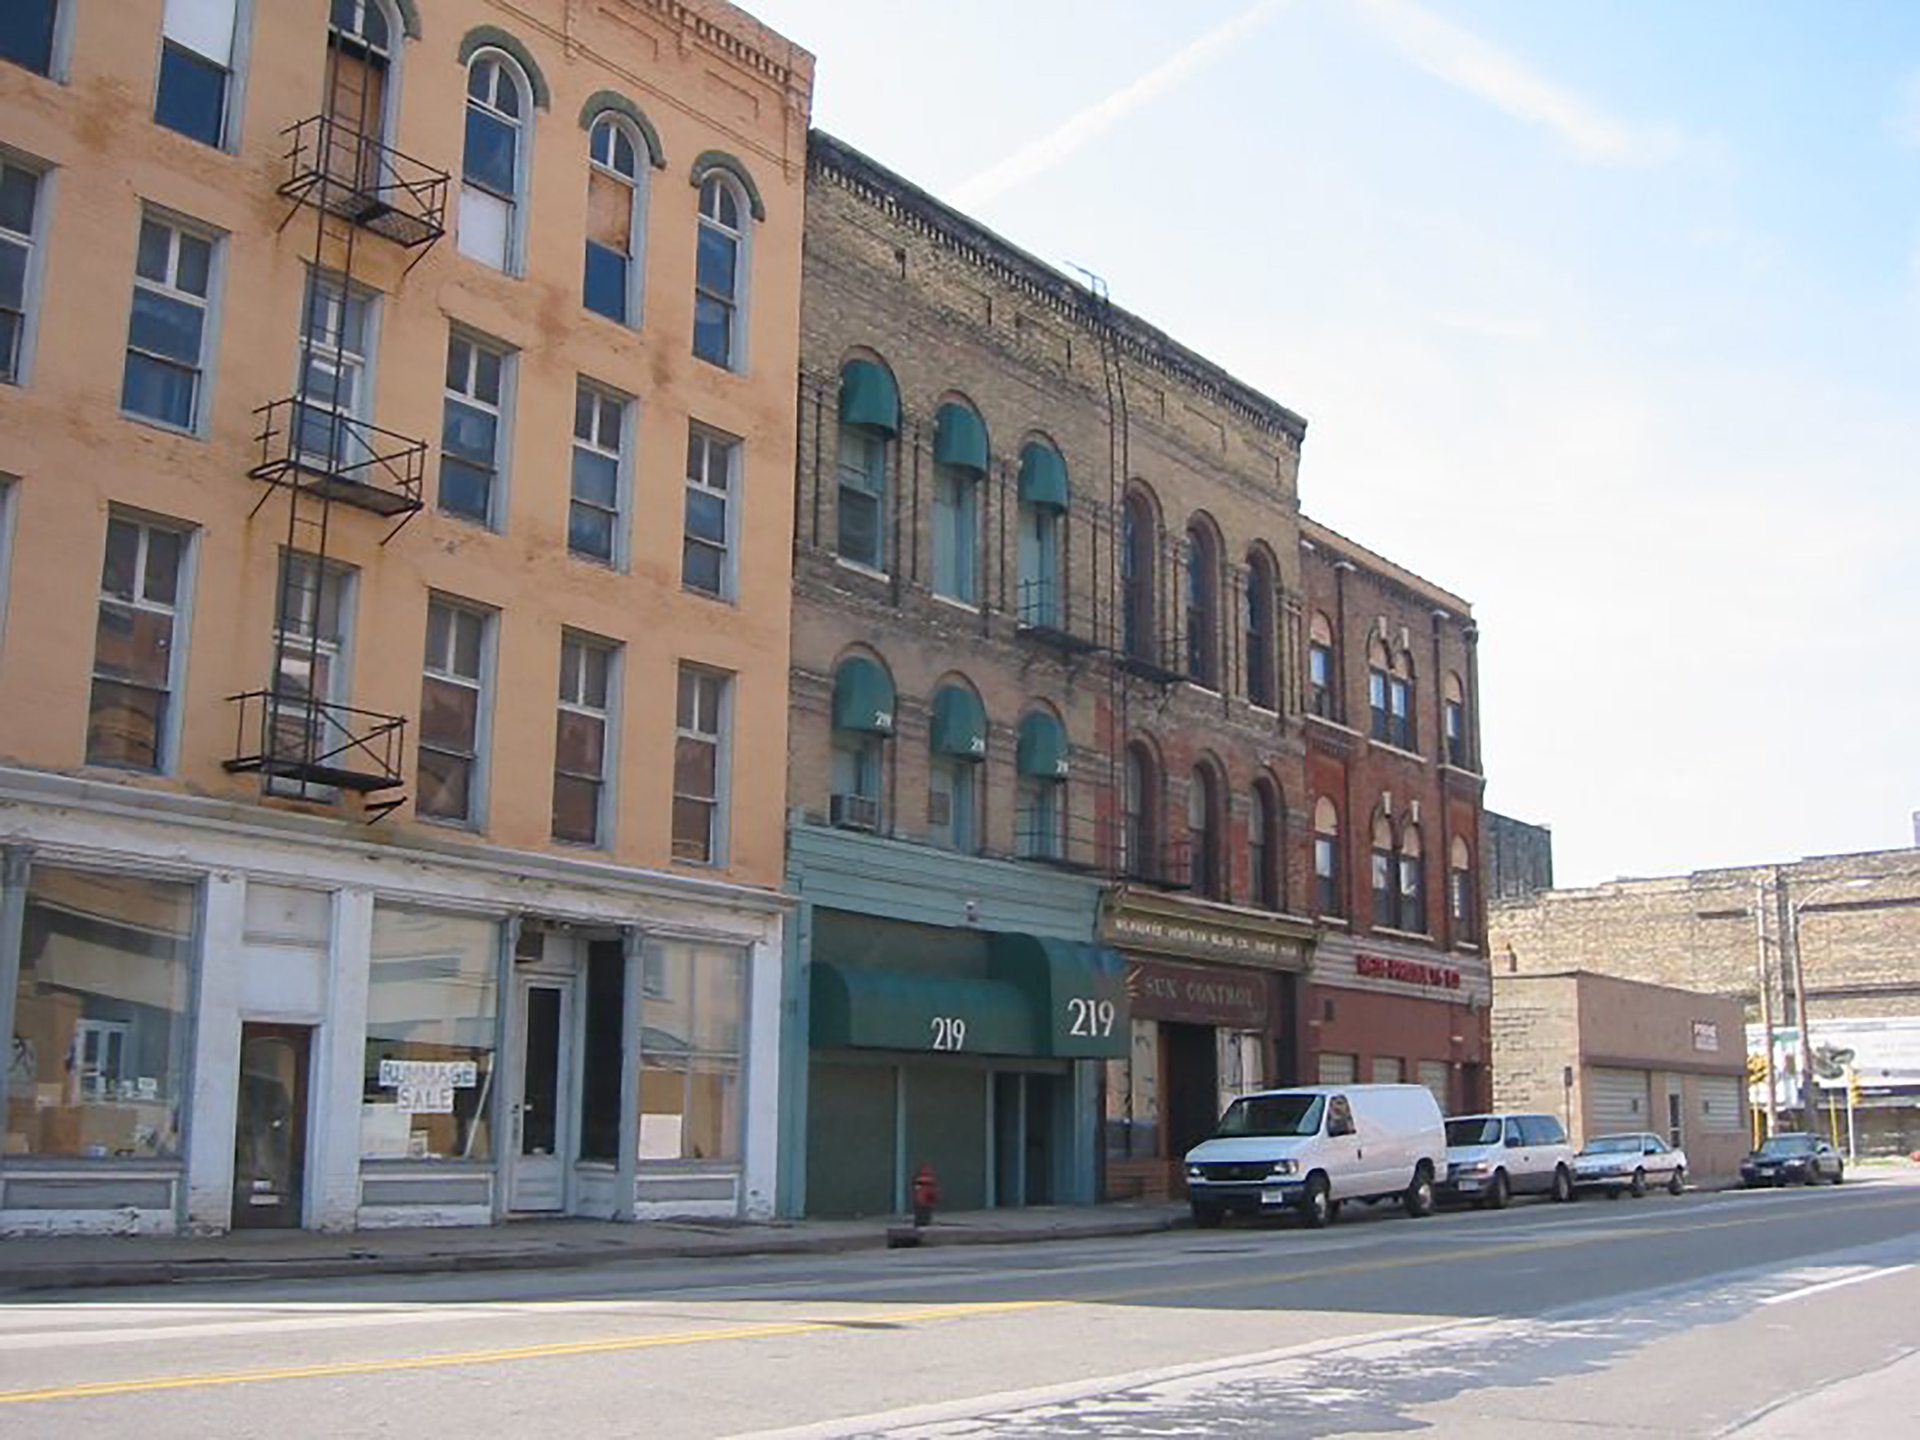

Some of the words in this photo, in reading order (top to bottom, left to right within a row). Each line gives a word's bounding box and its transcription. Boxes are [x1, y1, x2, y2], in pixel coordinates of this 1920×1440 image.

[1146, 976, 1178, 999] SUN
[1186, 981, 1253, 1008] CONTROL
[1067, 997, 1115, 1037] 219
[931, 1017, 965, 1051] 219
[400, 1087, 452, 1109] SALE
